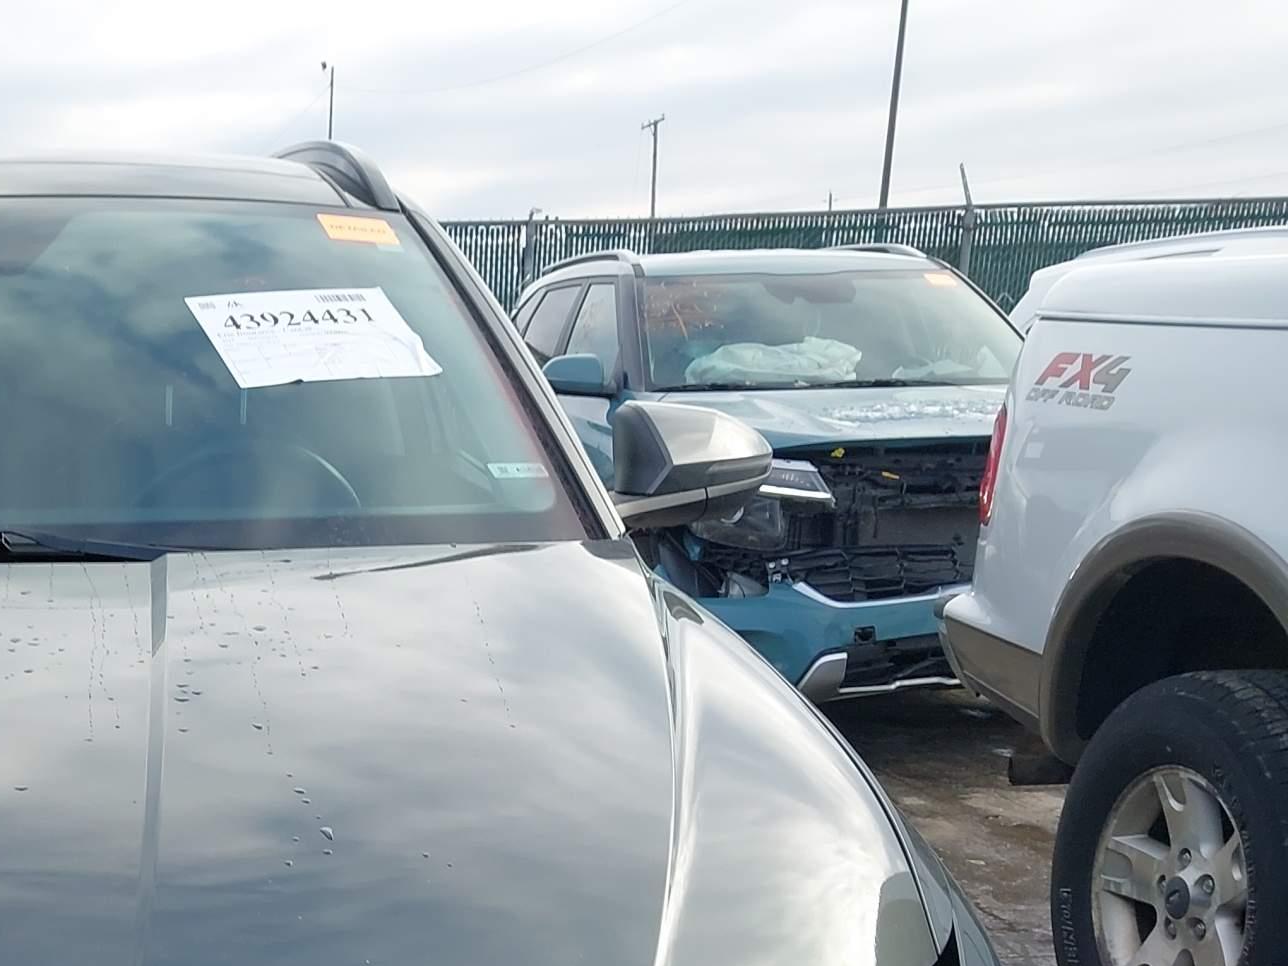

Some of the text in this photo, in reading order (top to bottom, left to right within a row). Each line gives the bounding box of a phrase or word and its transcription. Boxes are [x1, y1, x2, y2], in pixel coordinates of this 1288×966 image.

[223, 308, 375, 330] 43924431
[1035, 352, 1132, 393] FX4
[1025, 387, 1115, 410] OFF ROAD
